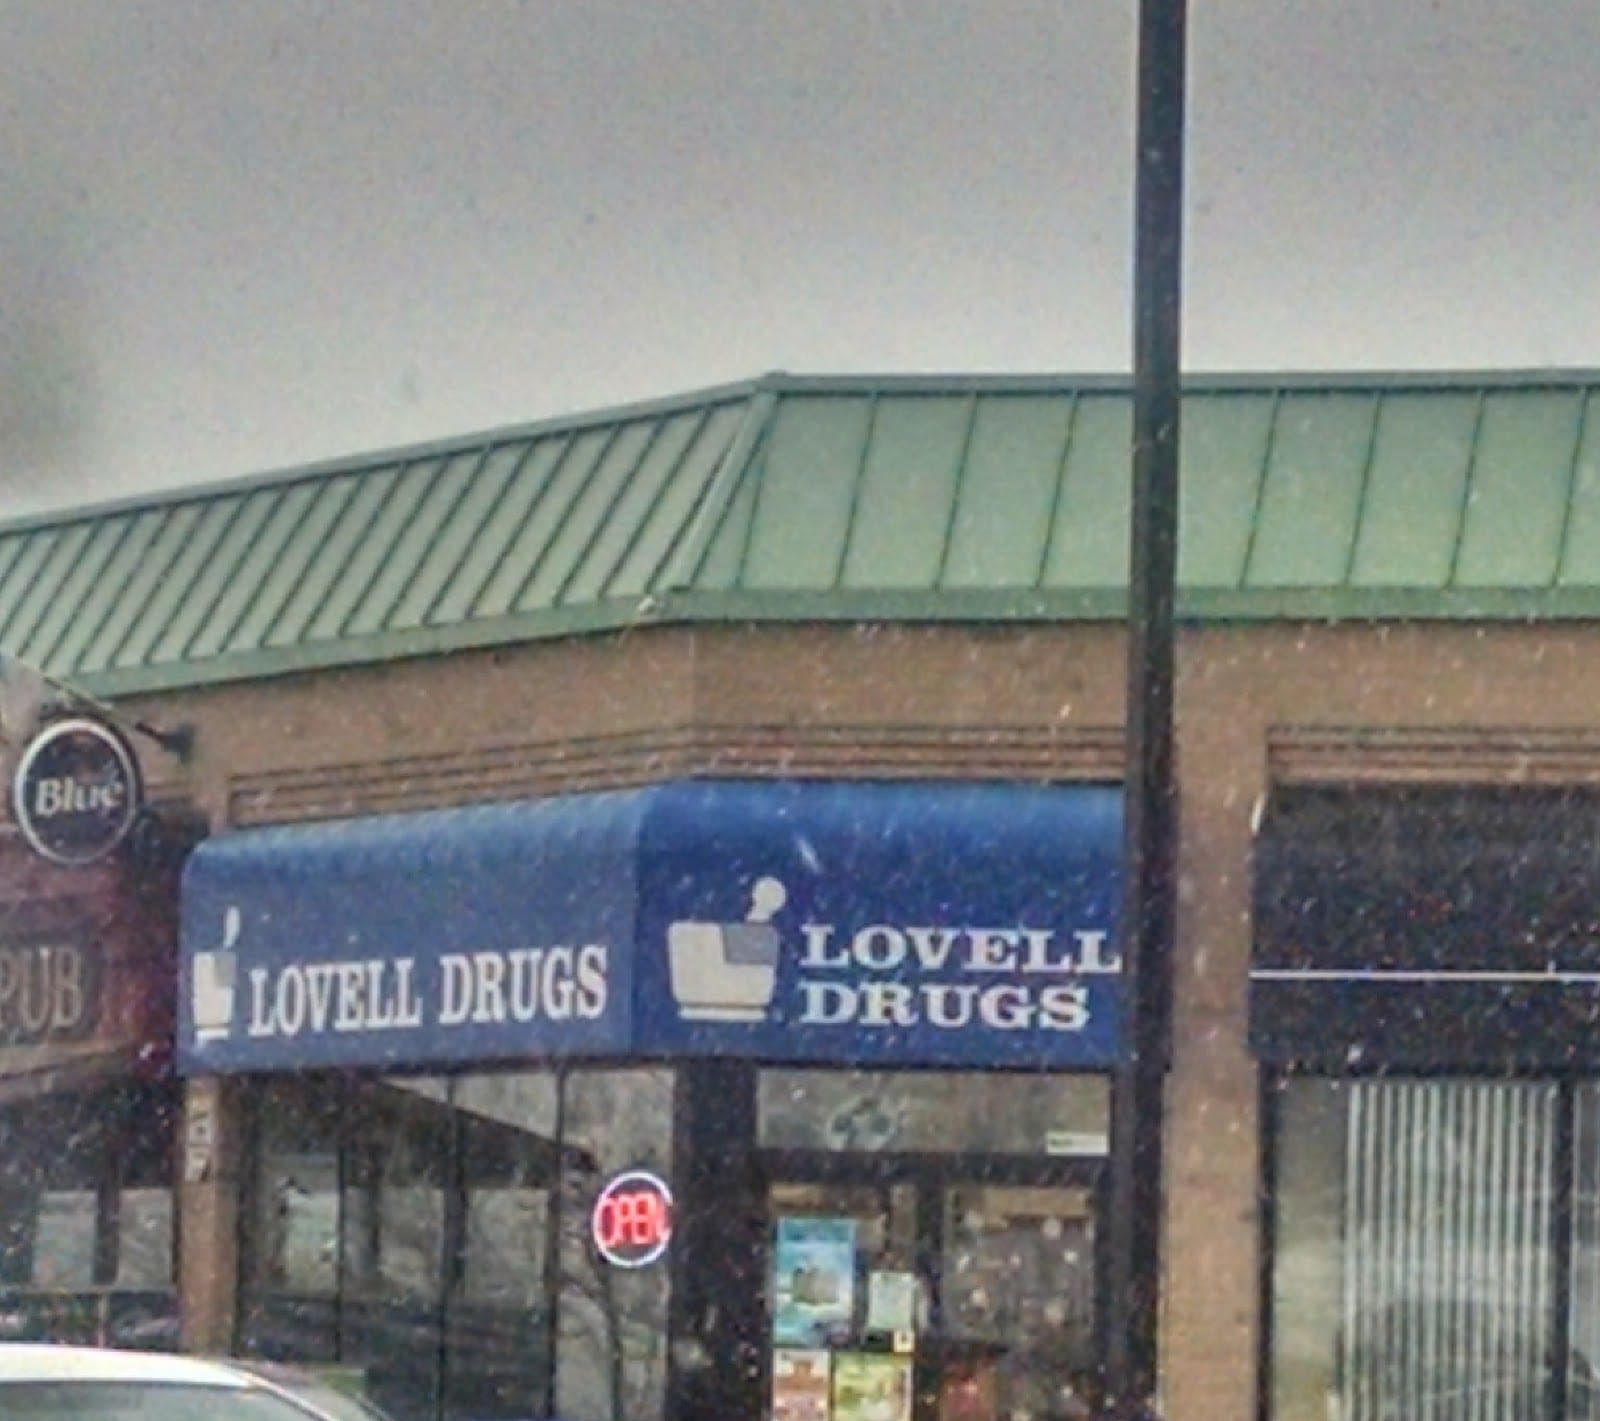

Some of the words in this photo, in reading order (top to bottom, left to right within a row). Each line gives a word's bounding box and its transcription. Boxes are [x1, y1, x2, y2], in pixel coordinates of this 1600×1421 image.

[37, 776, 124, 816] Blue
[801, 924, 1122, 974] LOVELL
[249, 957, 422, 1037] LOVELL
[439, 945, 607, 1025] DRUGS
[800, 979, 1090, 1031] DRUGS
